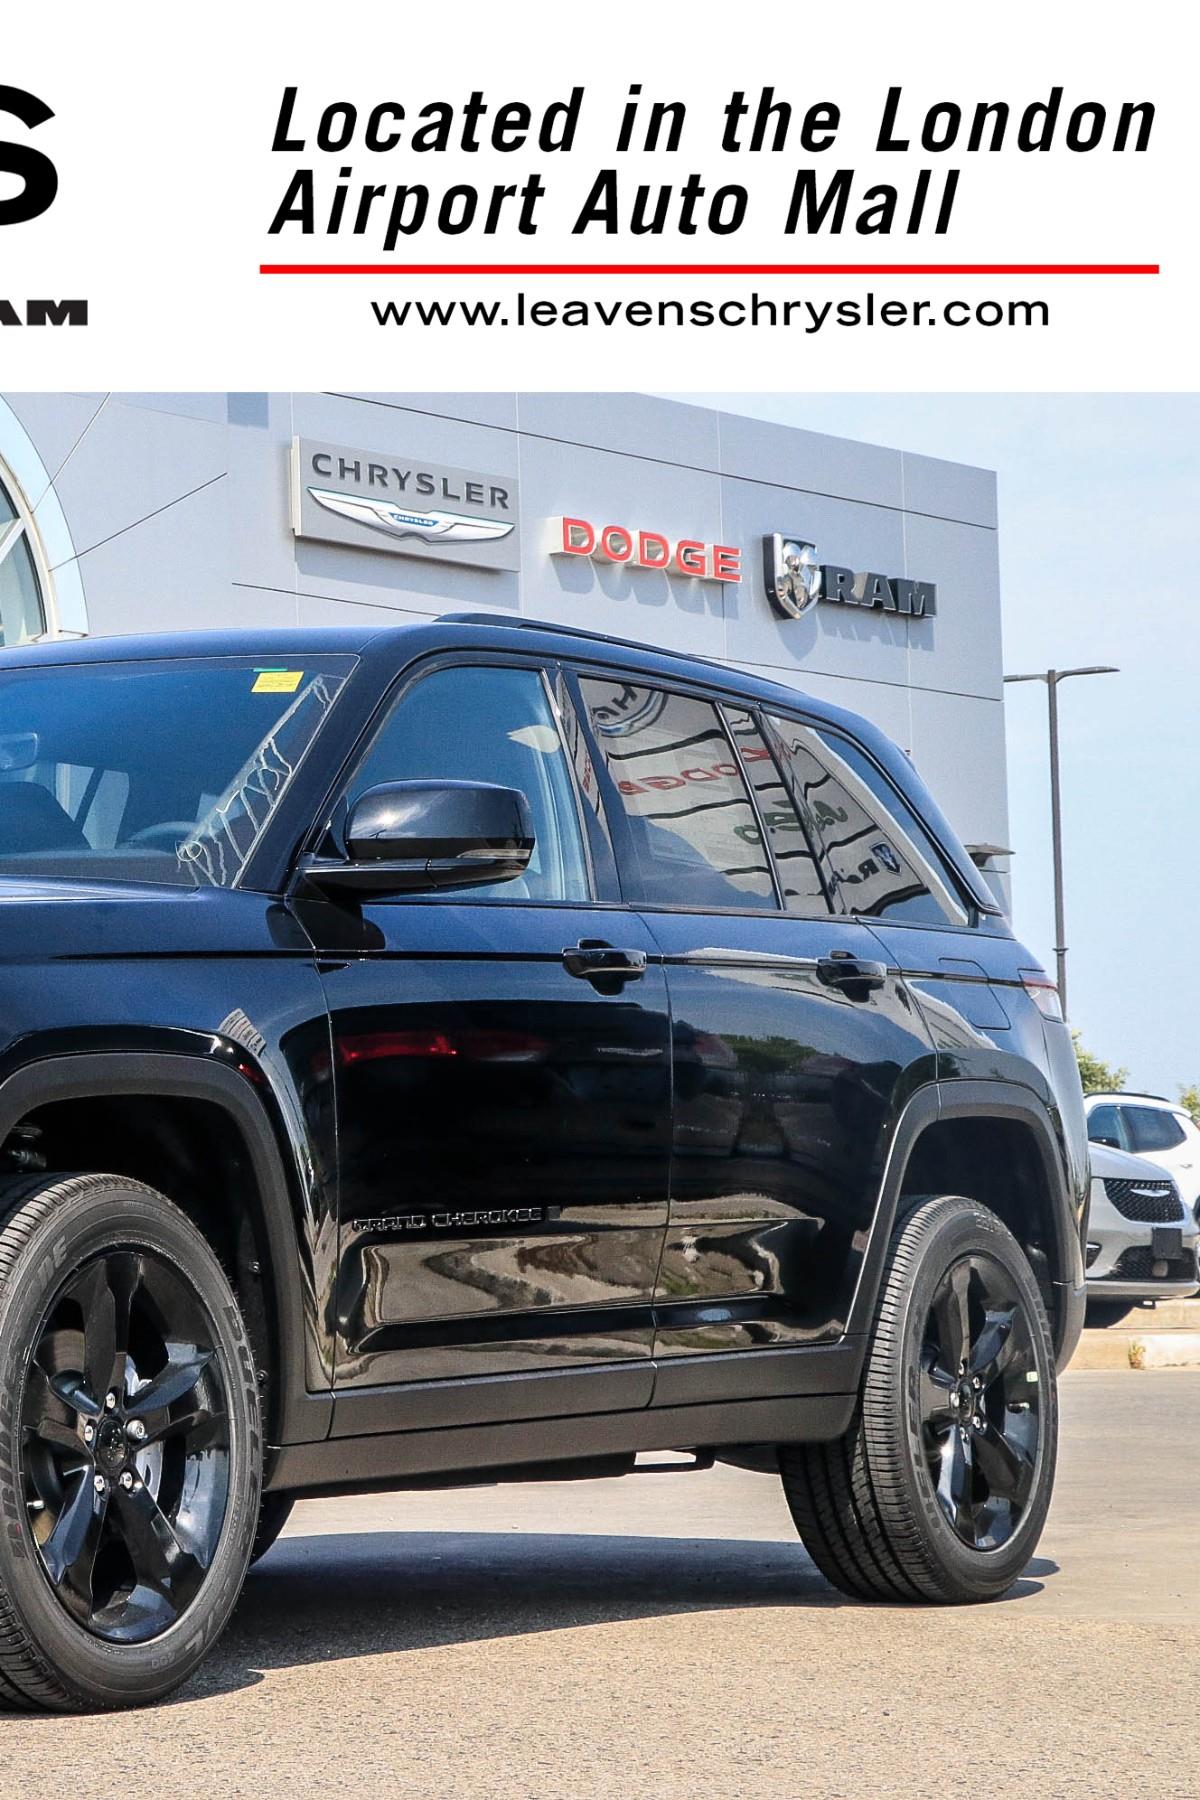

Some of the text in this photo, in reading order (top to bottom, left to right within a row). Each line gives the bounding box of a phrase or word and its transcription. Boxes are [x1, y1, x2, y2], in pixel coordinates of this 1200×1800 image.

[311, 452, 510, 510] CHRYSLER
[561, 516, 742, 583] DODGE
[820, 564, 937, 618] RAM
[351, 1196, 543, 1233] GRAND CHEROKEE
